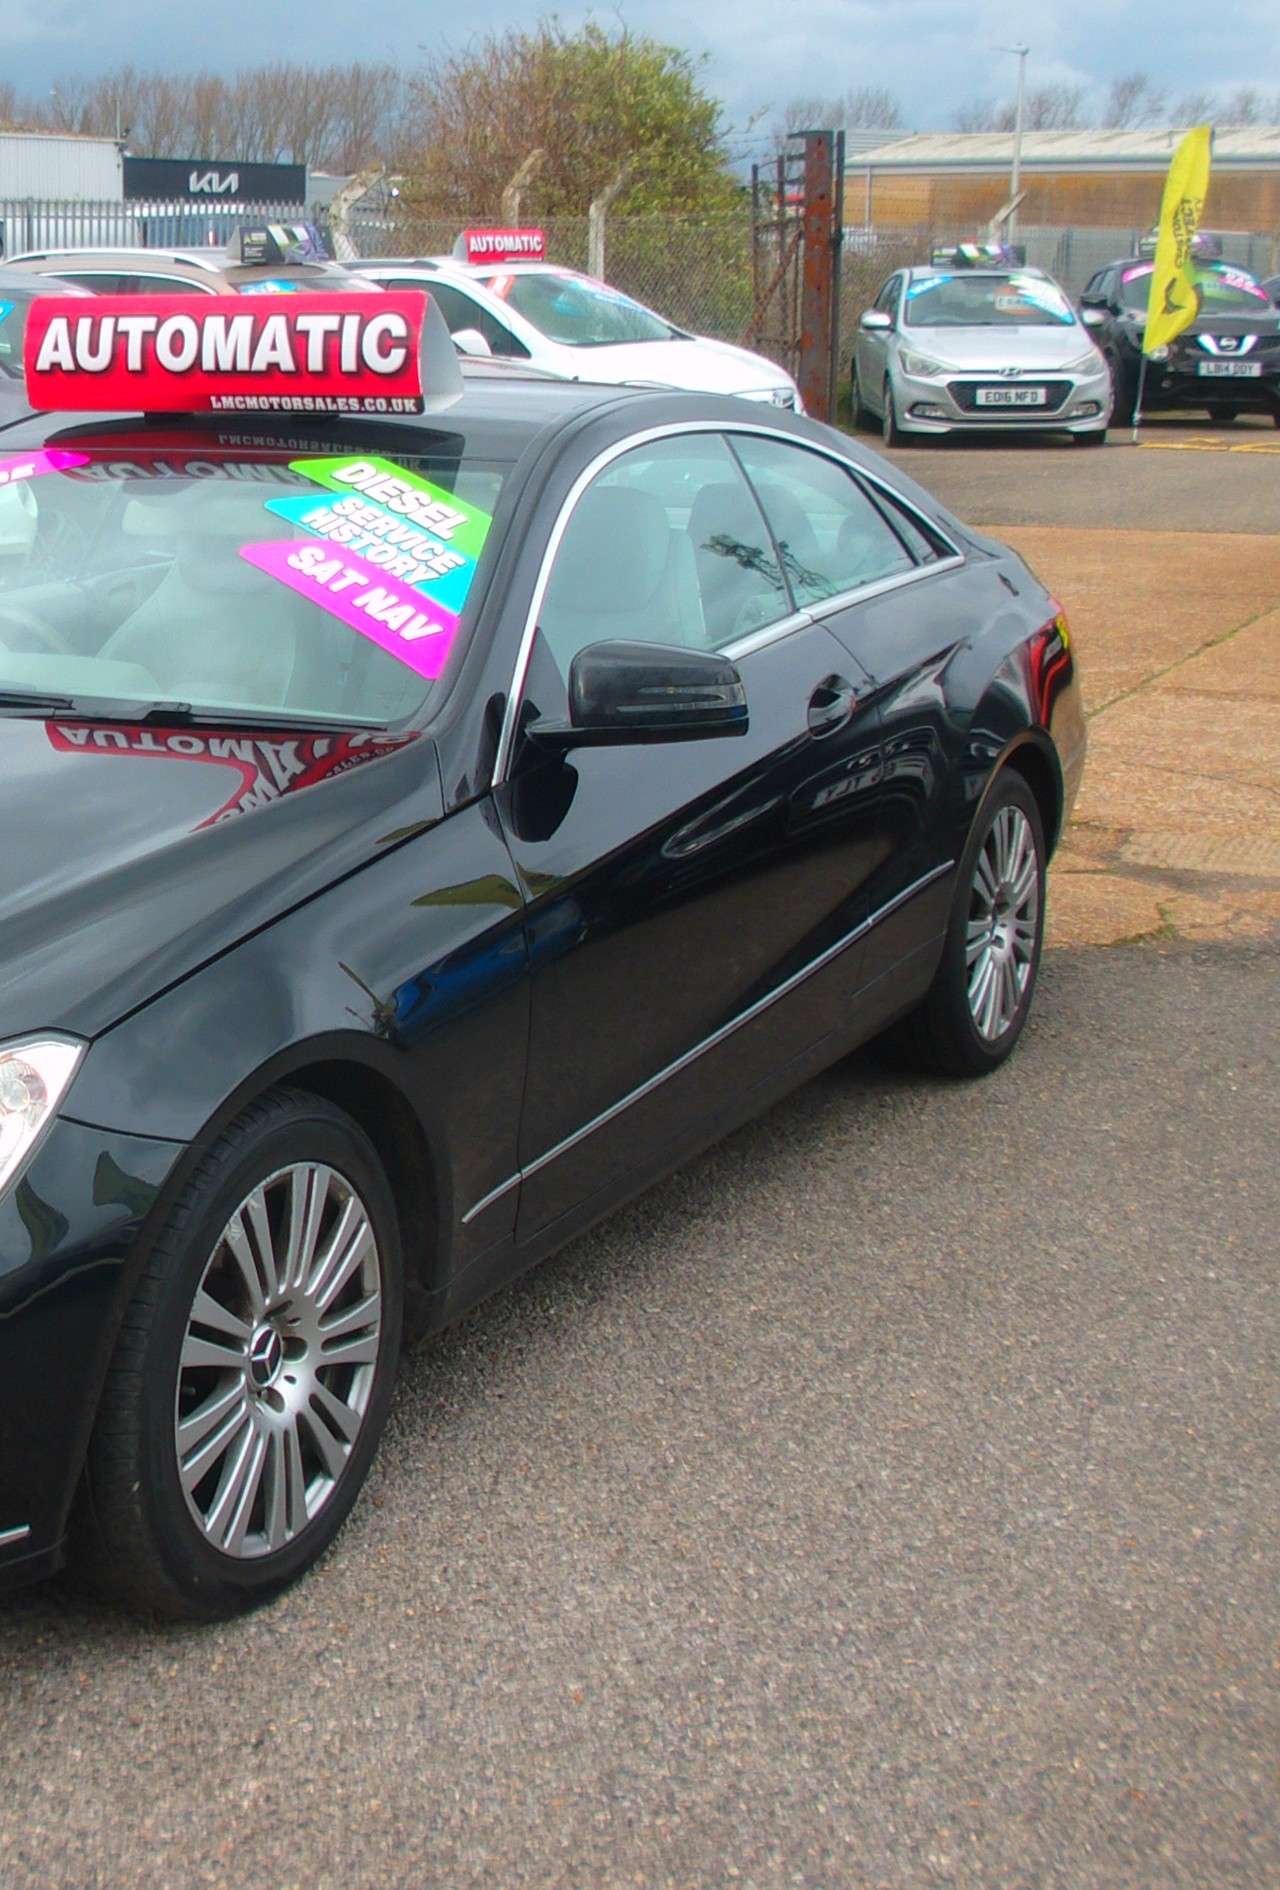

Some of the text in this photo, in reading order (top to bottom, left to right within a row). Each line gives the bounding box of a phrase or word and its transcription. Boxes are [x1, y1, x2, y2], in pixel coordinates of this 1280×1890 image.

[470, 235, 542, 252] AUTOMATIC
[35, 312, 409, 375] AUTOMATIC
[210, 394, 418, 413] LMCMOTORSALES.CO.UK
[330, 461, 469, 541] DIESEL
[330, 495, 468, 575] SERVICE
[299, 506, 441, 586] HISTORY
[286, 546, 445, 641] SAT NAV
